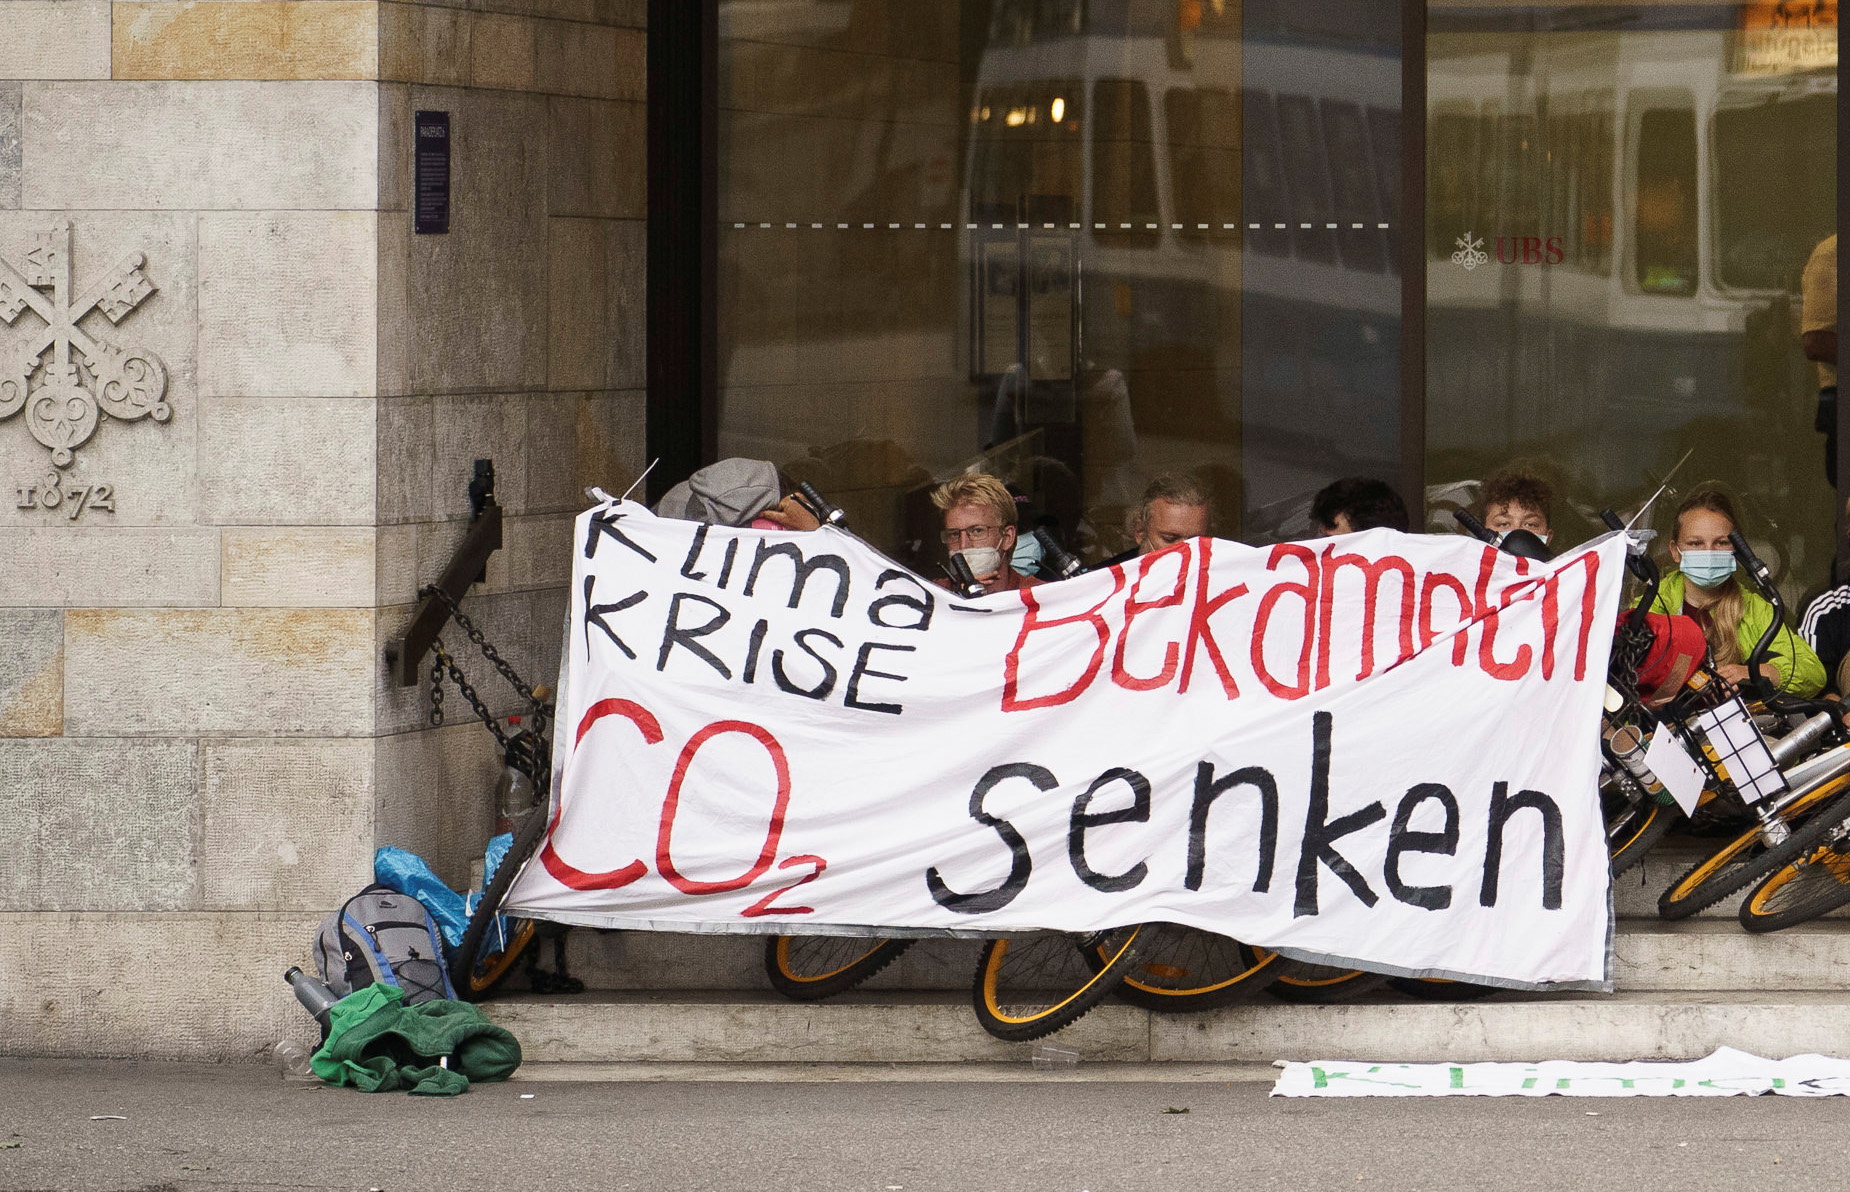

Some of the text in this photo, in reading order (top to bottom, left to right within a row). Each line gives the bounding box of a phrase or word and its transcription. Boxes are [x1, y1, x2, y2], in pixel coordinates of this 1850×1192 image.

[1496, 235, 1564, 265] UBS
[17, 470, 116, 520] 1872
[585, 510, 993, 630] Klima-
[585, 575, 917, 715] KRISE
[926, 710, 1564, 920] senken
